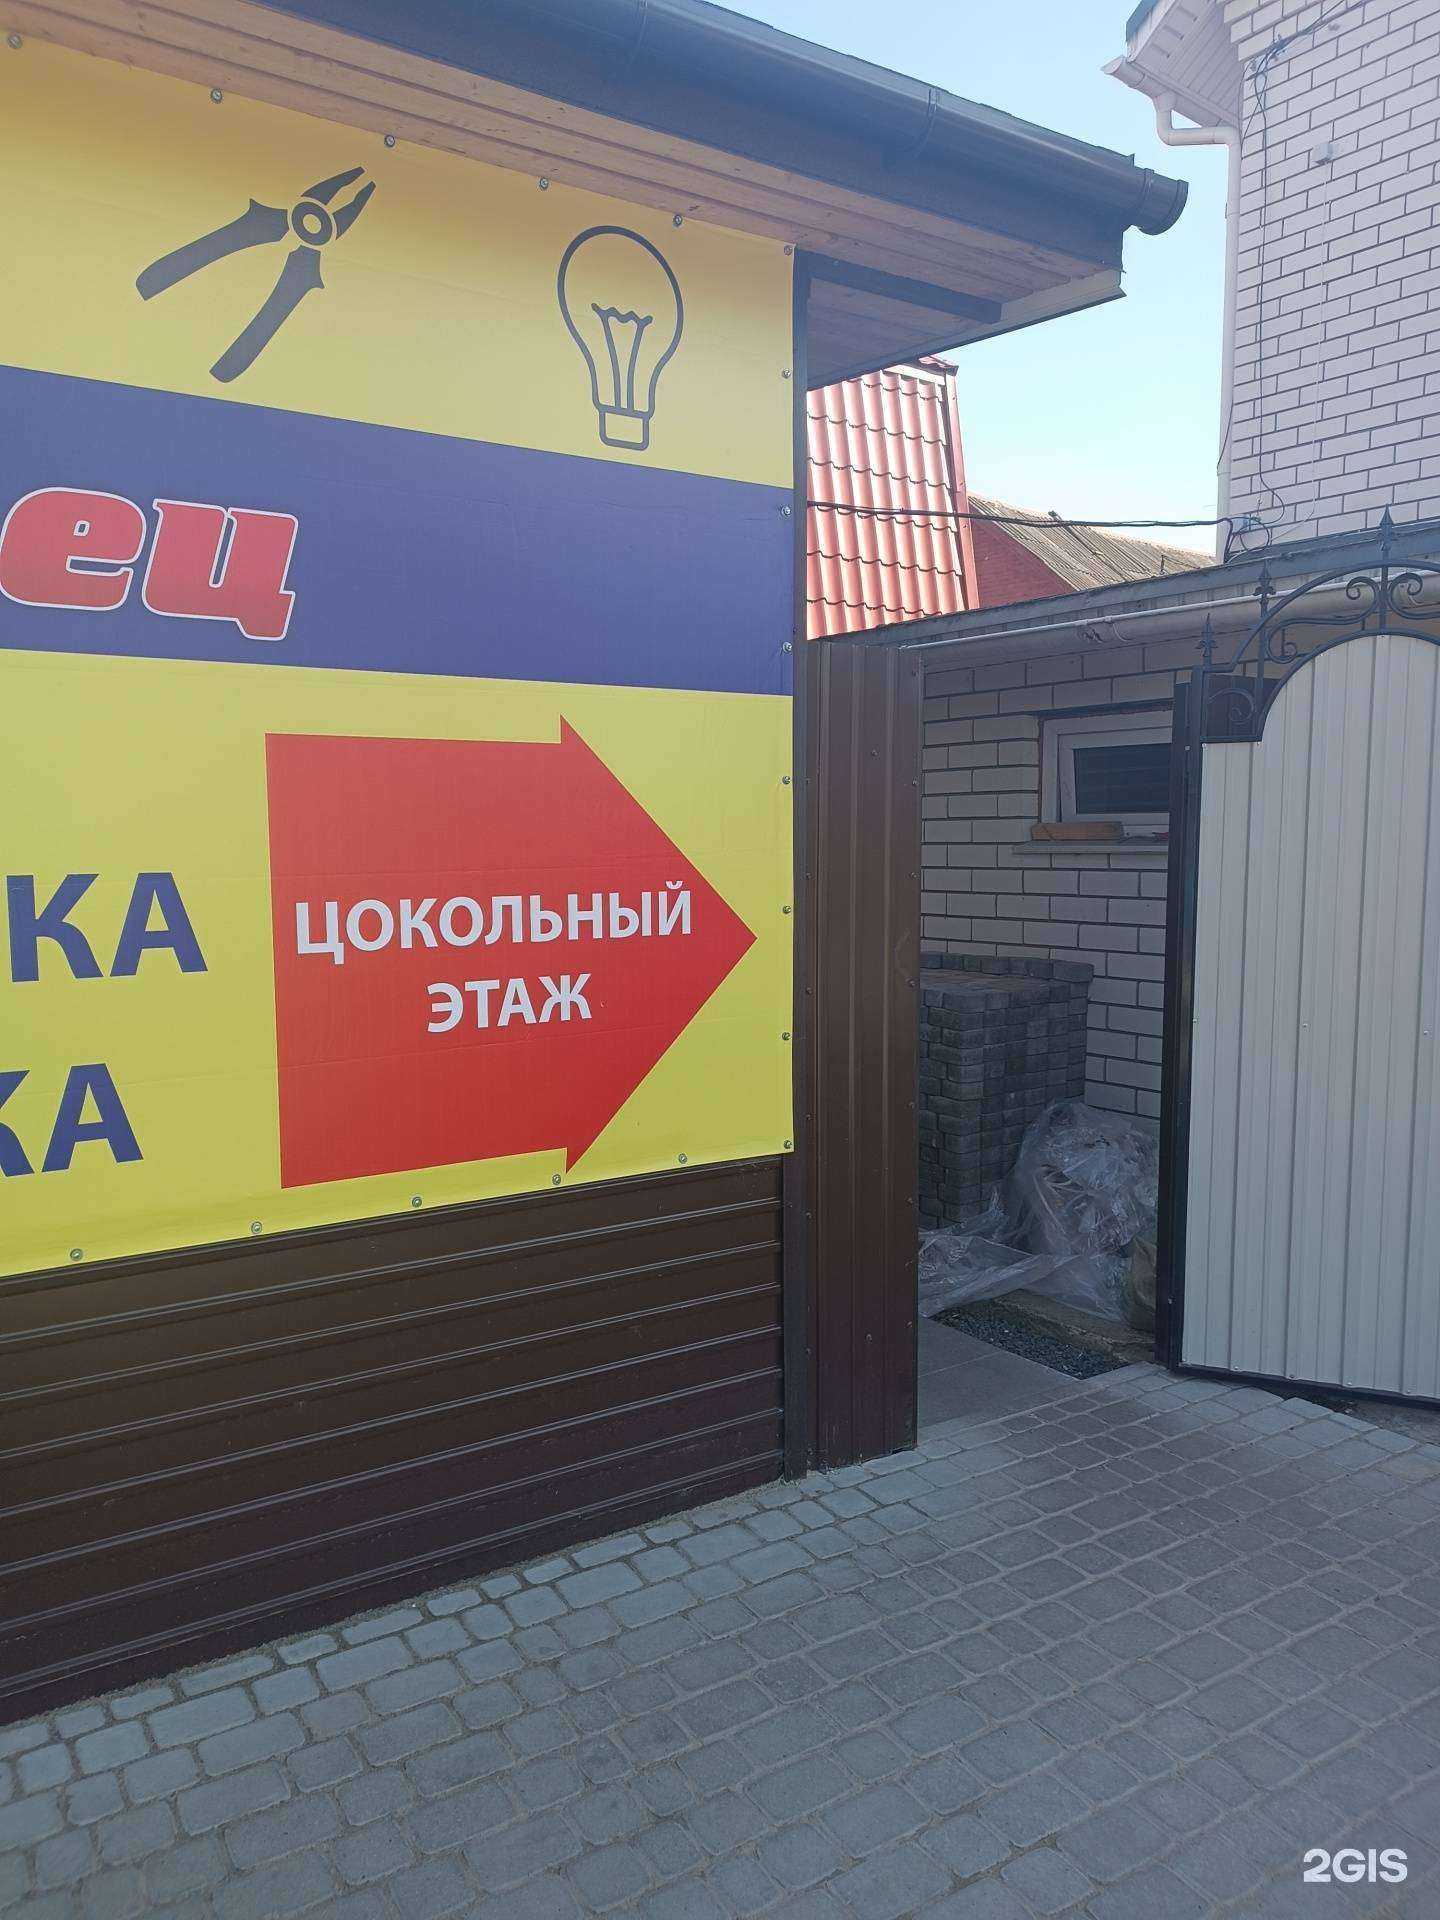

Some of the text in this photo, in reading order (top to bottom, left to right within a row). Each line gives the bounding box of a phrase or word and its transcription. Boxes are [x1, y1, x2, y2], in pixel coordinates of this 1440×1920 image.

[7, 872, 208, 982] КА
[295, 880, 692, 965] ЦОКОЛЬНЫЙ
[426, 973, 592, 1033] ЭТАЖ
